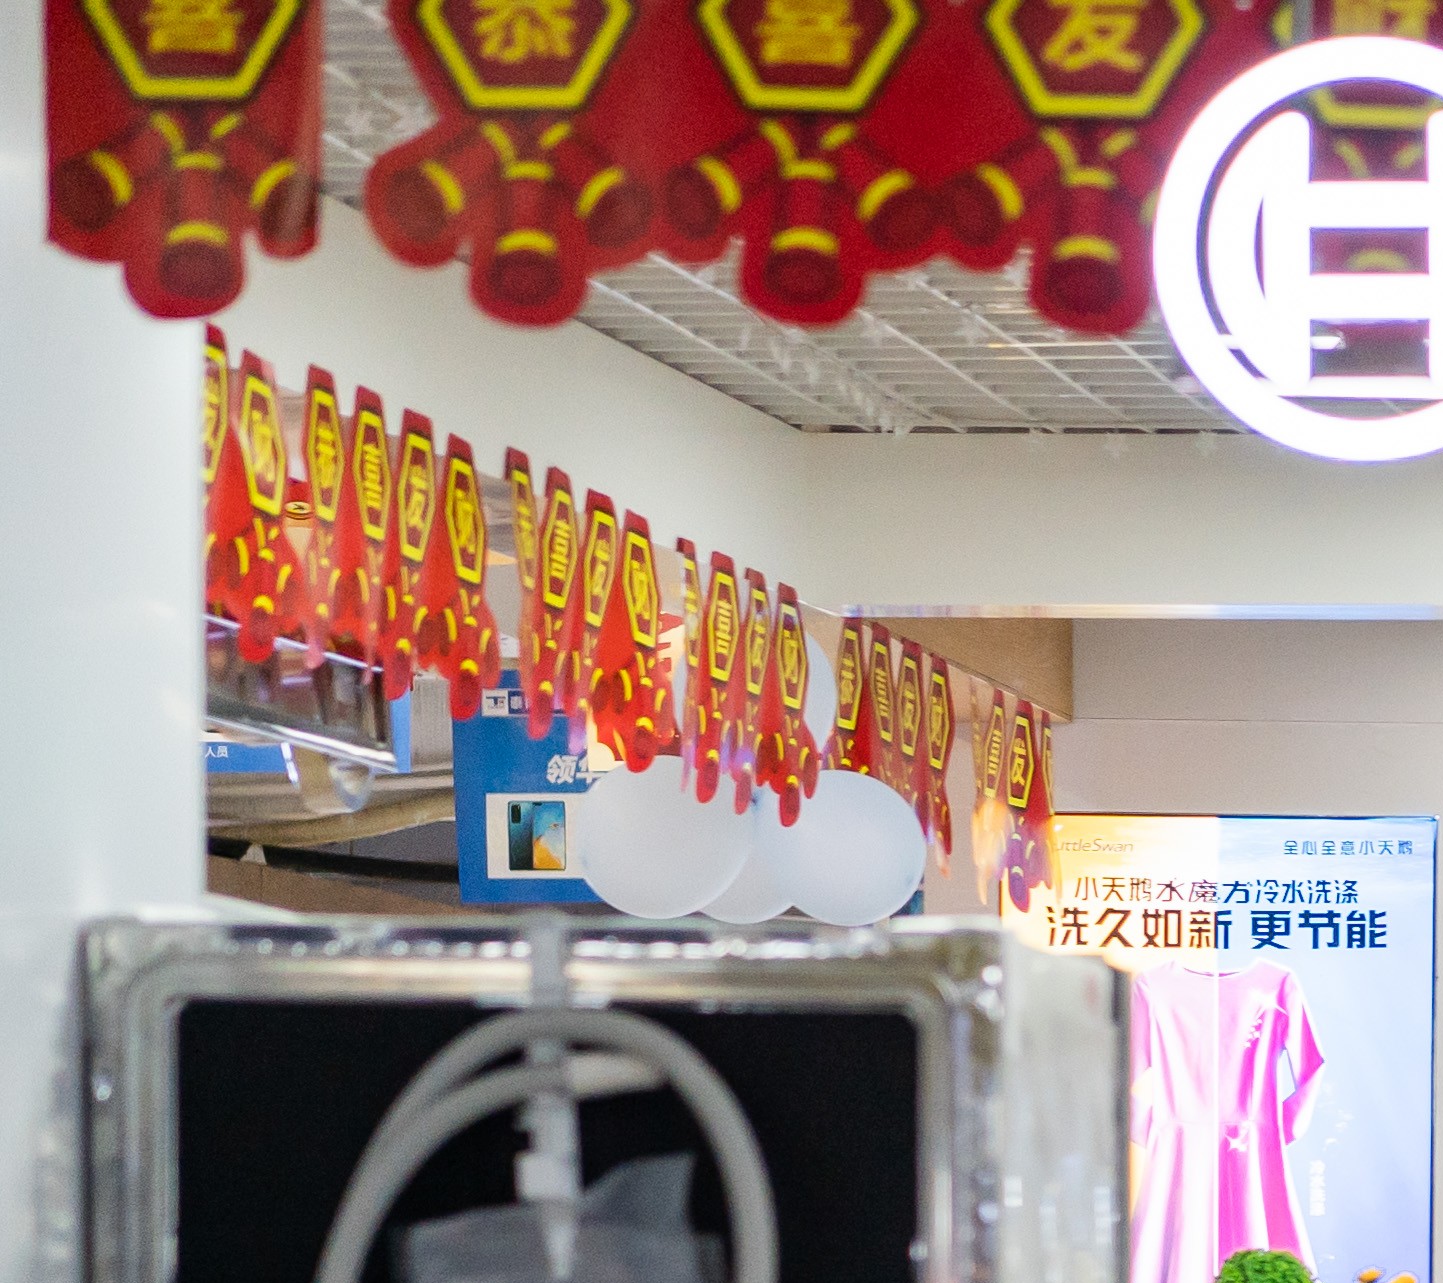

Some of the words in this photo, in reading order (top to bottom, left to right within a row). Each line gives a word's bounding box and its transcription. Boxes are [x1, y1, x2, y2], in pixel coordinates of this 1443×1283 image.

[1282, 839, 1414, 857] 全心全意小天鹅
[1074, 876, 1360, 905] 小天鹅水魔方冷水洗涤
[1045, 905, 1235, 950] 洗久如新
[1249, 909, 1389, 951] 更节能
